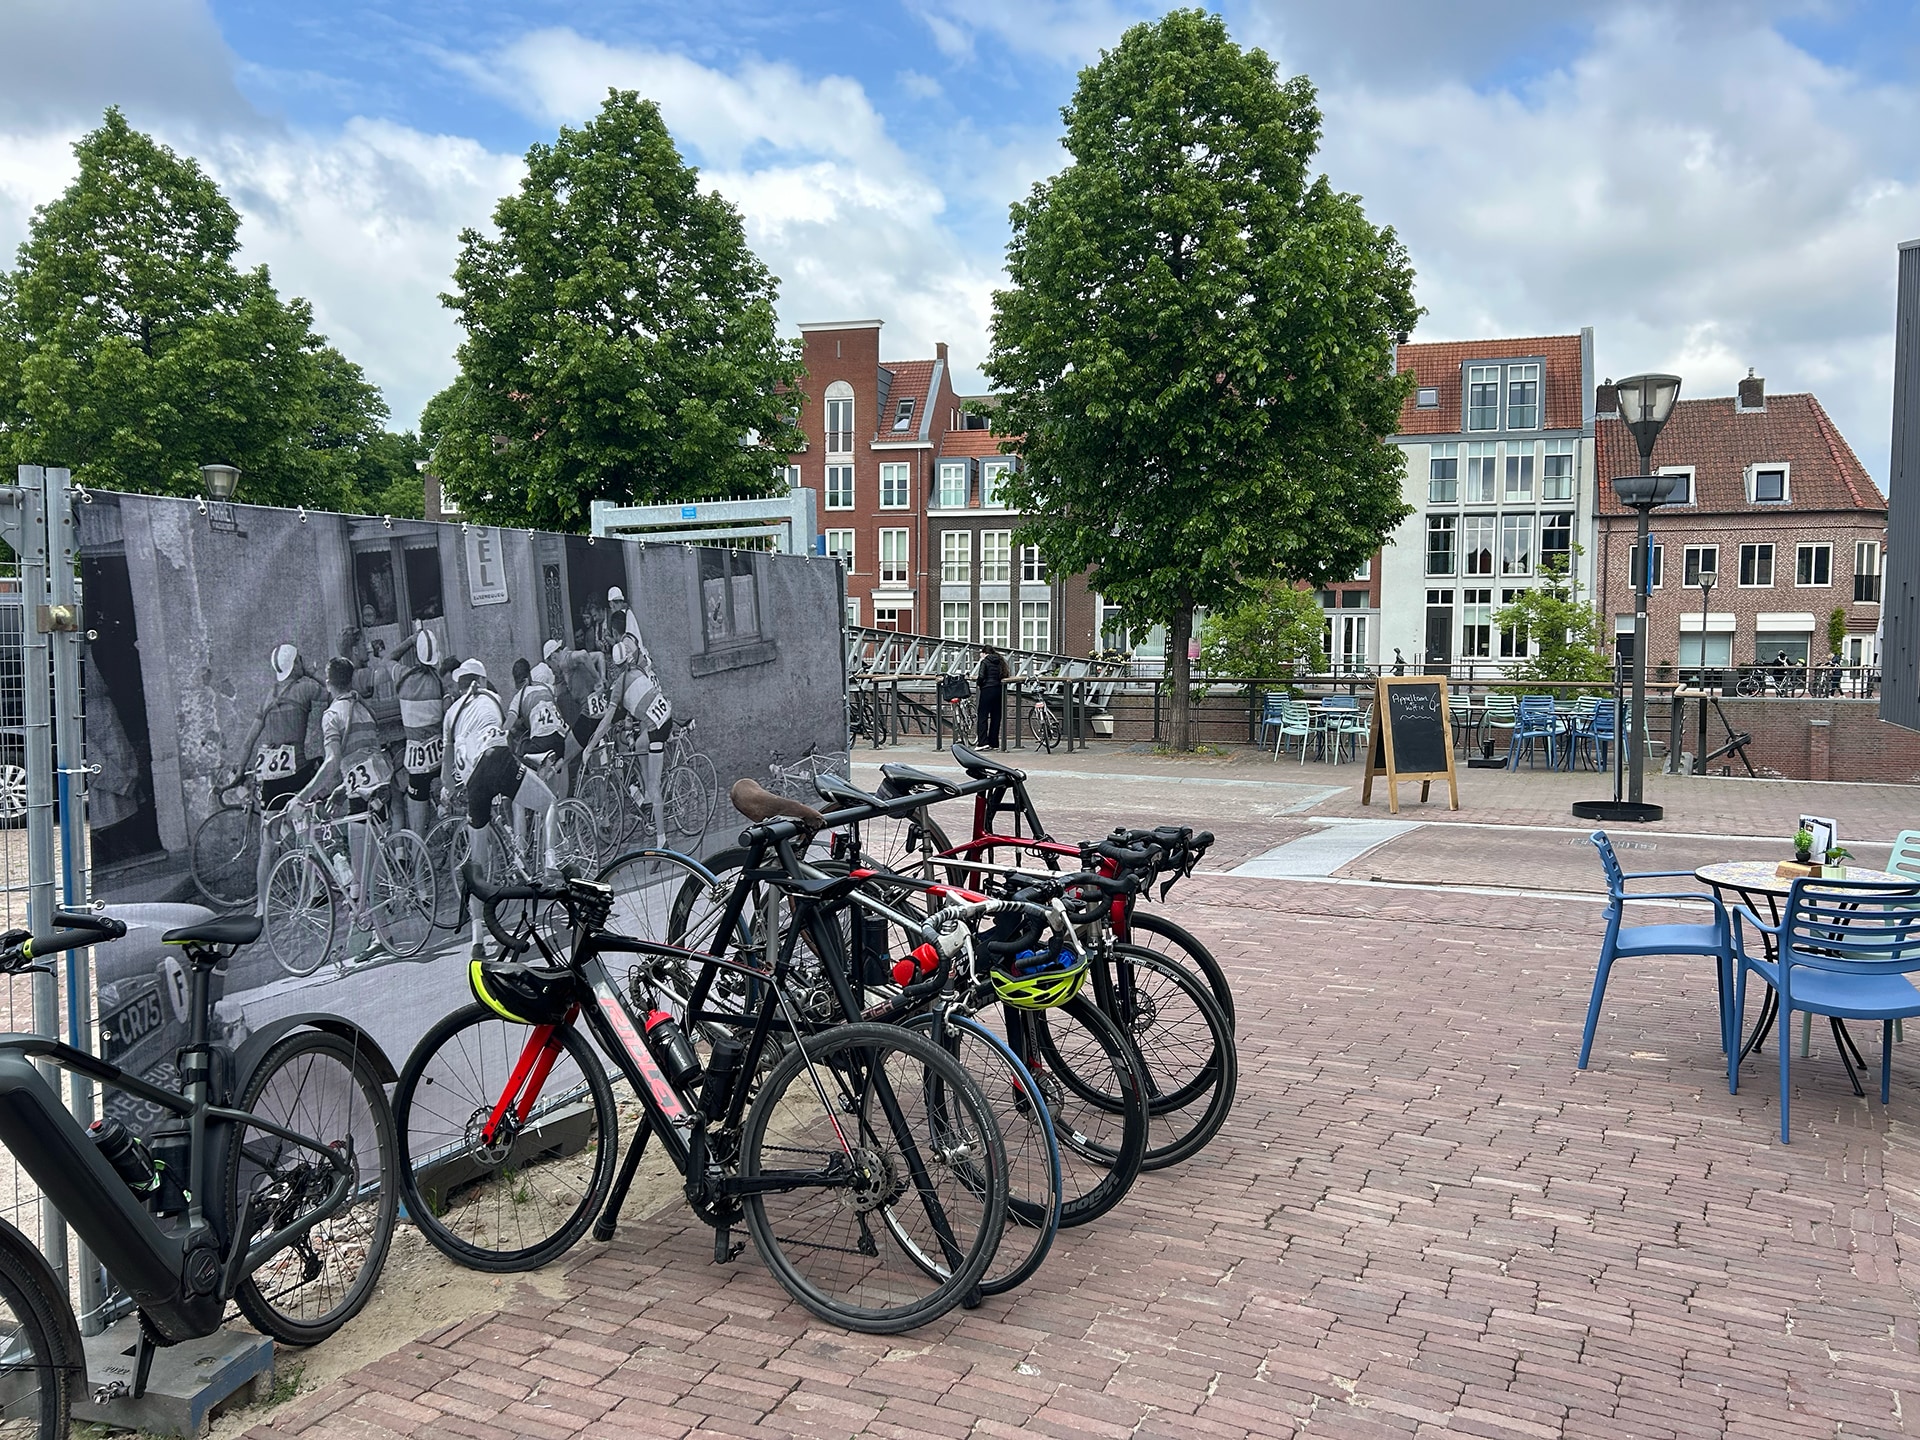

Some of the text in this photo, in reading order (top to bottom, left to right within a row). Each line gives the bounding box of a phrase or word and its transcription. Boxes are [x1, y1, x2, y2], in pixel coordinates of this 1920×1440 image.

[538, 708, 554, 725] 42
[651, 699, 667, 721] 116
[347, 764, 371, 794] 23
[172, 969, 185, 1008] F
